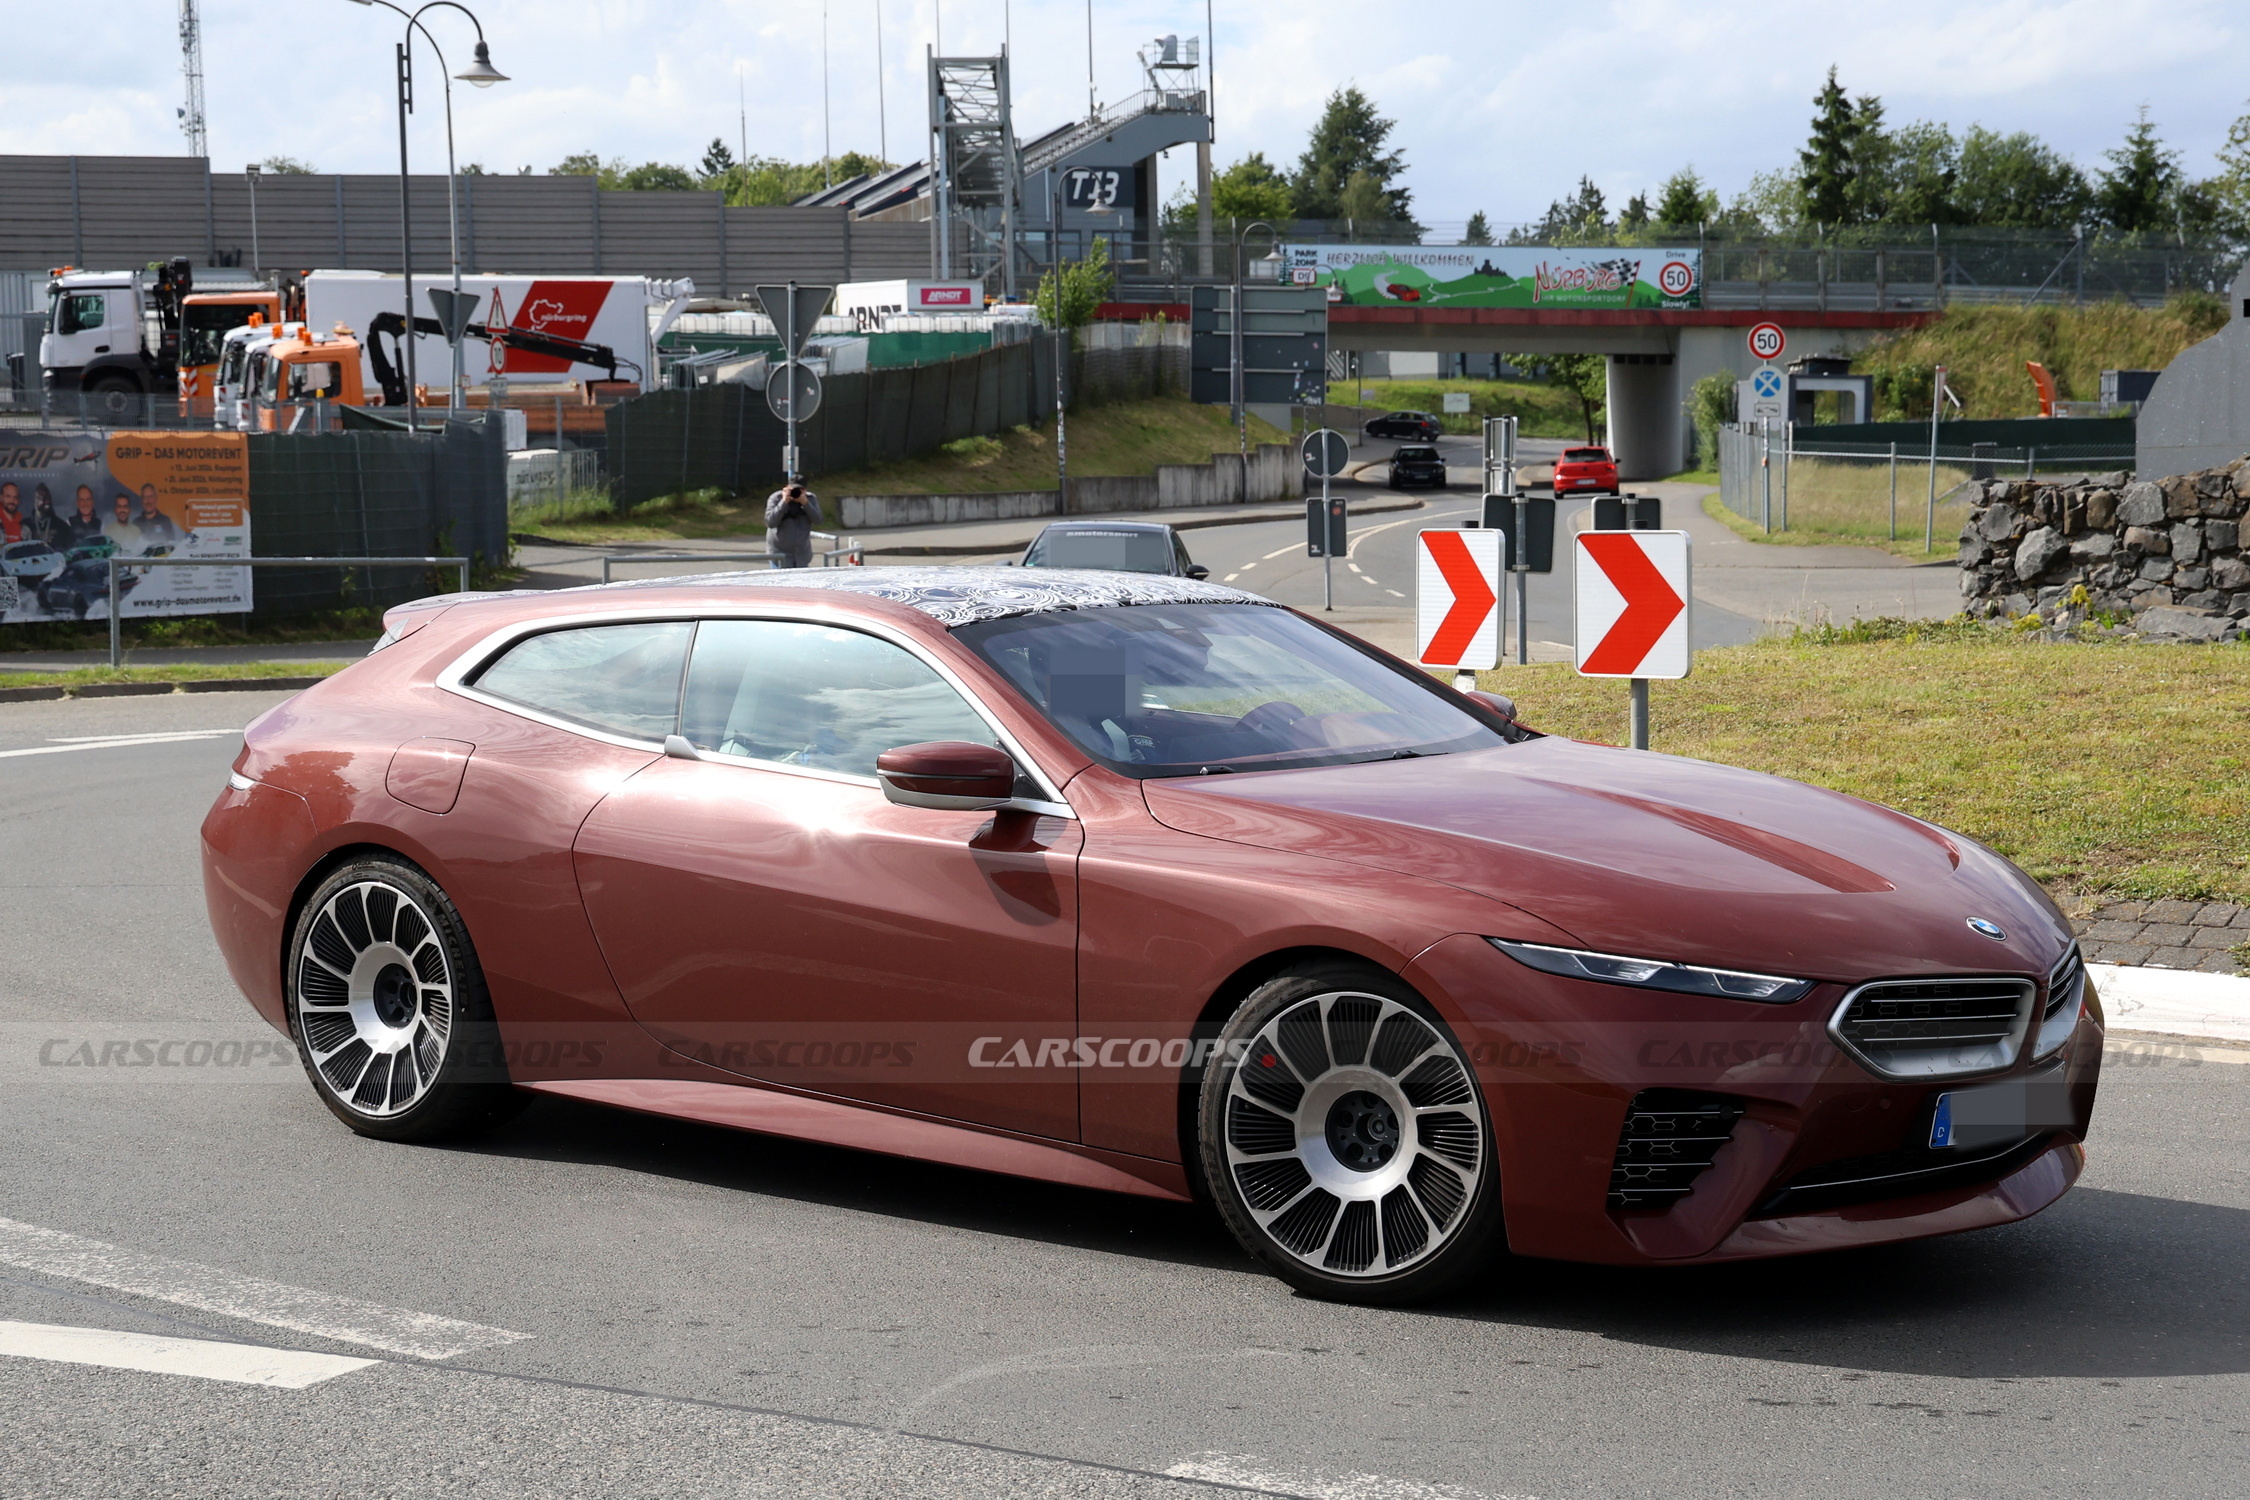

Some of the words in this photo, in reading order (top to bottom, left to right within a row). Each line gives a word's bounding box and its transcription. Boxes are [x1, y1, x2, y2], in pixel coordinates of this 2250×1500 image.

[1071, 170, 1120, 205] T13
[1295, 250, 1317, 258] PARK
[1327, 252, 1387, 265] HERZLICH
[1393, 253, 1475, 265] WILLKOMMEN
[1666, 270, 1686, 287] 50
[927, 291, 963, 302] ARNDT
[1661, 300, 1690, 310] Slowly!
[541, 313, 588, 323] nürburgring
[1757, 333, 1778, 350] 50
[115, 447, 142, 459] GRIP
[154, 447, 175, 459] DAS
[176, 447, 242, 459] MOTOREVENT
[132, 594, 241, 608] www.grip-dasmotorevent.de
[1937, 1125, 1945, 1139] D
